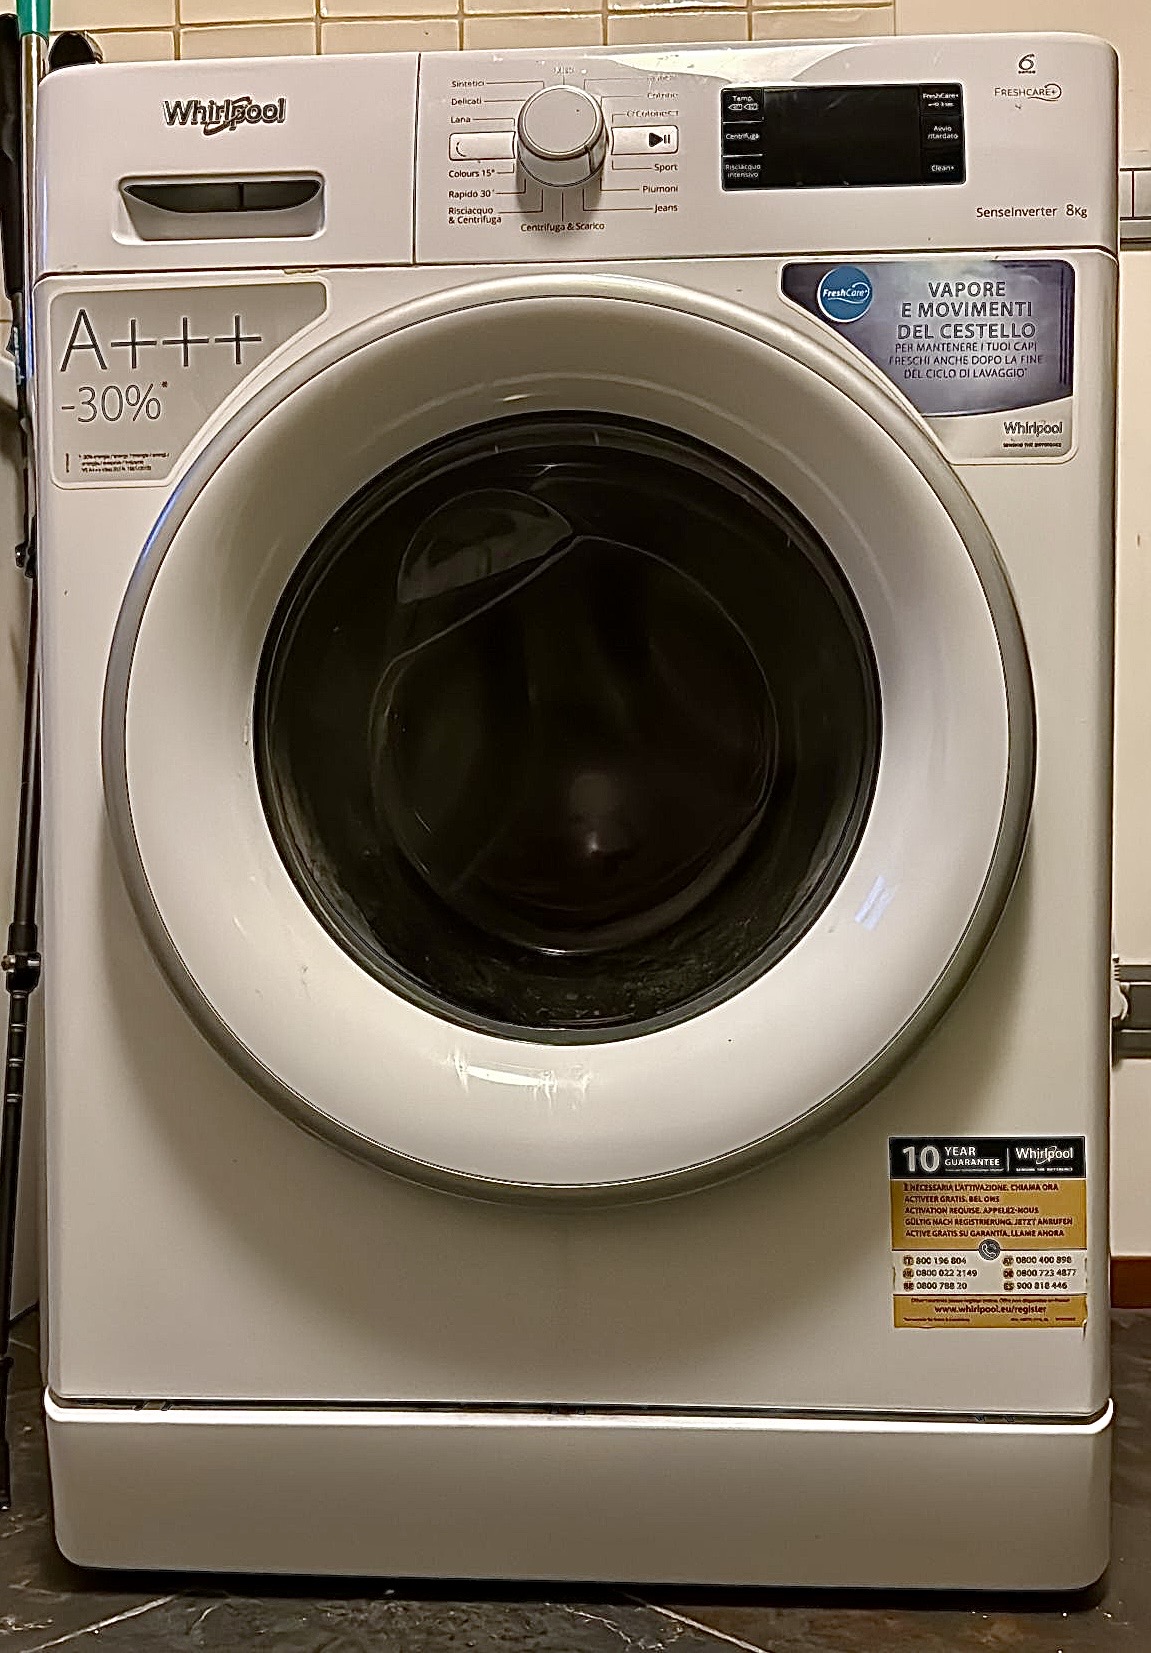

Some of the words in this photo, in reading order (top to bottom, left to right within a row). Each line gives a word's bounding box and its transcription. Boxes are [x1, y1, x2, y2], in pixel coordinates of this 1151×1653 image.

[451, 80, 485, 88] Sintetici
[451, 97, 482, 106] Delicati
[164, 96, 286, 135] Whirlpool
[450, 116, 471, 124] Lana
[725, 132, 760, 140] Centrifuga
[654, 163, 678, 173] Sport
[725, 163, 761, 172] Risciacquo
[931, 164, 955, 172] Clean+
[448, 169, 480, 178] Colours
[642, 184, 679, 194] Piumoni
[448, 190, 478, 200] Rapido
[448, 207, 494, 217] Risciacquo
[654, 203, 678, 213] Jeans
[976, 207, 1058, 218] SenseInverter
[1066, 203, 1088, 218] 8Kg
[448, 216, 455, 224] &
[457, 215, 502, 226] Centrifuga
[520, 222, 565, 233] Centrifuga
[567, 222, 574, 231] &
[576, 222, 605, 231] Scarico
[928, 281, 1006, 297] VAPORE
[901, 302, 912, 317] E
[918, 301, 1032, 317] MOVIMENTI
[897, 323, 934, 339] DEL
[939, 322, 1036, 338] CESTELLO
[60, 309, 262, 371] A+++
[895, 343, 913, 352] PER
[917, 342, 977, 352] MANTENERE
[986, 342, 1011, 351] TUOI
[1013, 341, 1037, 351] CAPI
[889, 356, 930, 365] FRESCHI
[933, 356, 968, 365] ANCHE
[971, 355, 1002, 364] DOPO
[1005, 355, 1017, 364] LA
[1020, 354, 1043, 364] FINE
[904, 369, 924, 378] DEL
[926, 369, 957, 378] CICLO
[959, 368, 970, 377] DI
[1003, 420, 1063, 437] Whirlpool
[944, 1146, 976, 1156] YEAR
[1015, 1145, 1074, 1165] Whirlpool
[902, 1146, 940, 1173] 10
[944, 1158, 1000, 1166] GUARANTEE
[910, 1183, 953, 1191] NECESSARIA
[1011, 1183, 1041, 1191] CHIAMA
[1042, 1183, 1059, 1191] ORA
[905, 1195, 939, 1203] ACTIVEER
[968, 1195, 982, 1203] BEL
[905, 1206, 947, 1214] ACTIVATION
[905, 1217, 931, 1226] GÜLTIG
[933, 1218, 953, 1226] NACH
[1013, 1218, 1036, 1226] JETZT
[1038, 1217, 1073, 1226] ANRUFEN
[906, 1229, 930, 1237] ACTIVE
[932, 1229, 957, 1237] GRATIS
[959, 1229, 969, 1237] SU
[1010, 1229, 1036, 1237] LLAME
[1038, 1229, 1064, 1237] AHORA
[916, 1256, 931, 1264] 800
[934, 1256, 949, 1264] 196
[1016, 1256, 1037, 1264] 0800
[1039, 1256, 1055, 1264] 400
[916, 1269, 937, 1277] 0800
[939, 1269, 954, 1277] 022
[956, 1269, 978, 1277] 2149
[1016, 1269, 1037, 1277] 0800
[1039, 1269, 1055, 1277] 723
[1056, 1268, 1077, 1277] 4877
[917, 1281, 937, 1290] 0800
[957, 1281, 967, 1290] 20
[1016, 1281, 1032, 1290] 900
[934, 1304, 1047, 1315] www.whirlpool.eu/register
